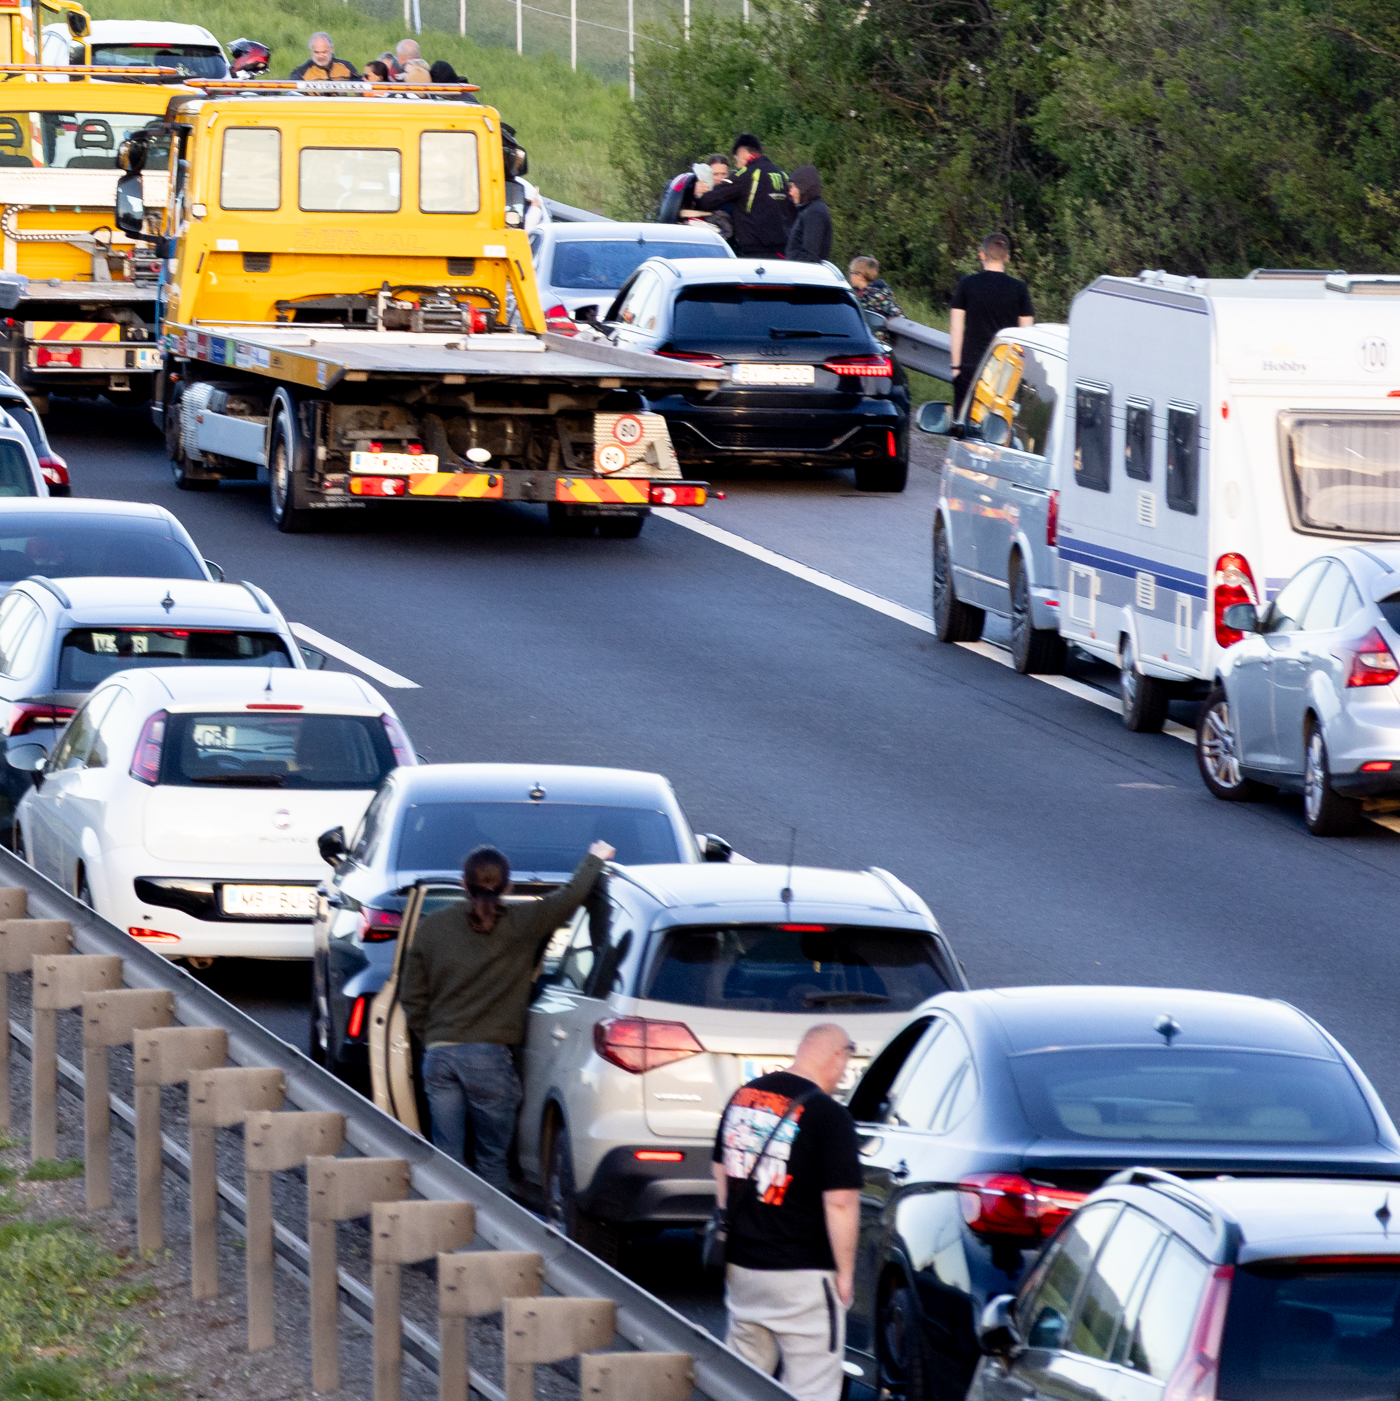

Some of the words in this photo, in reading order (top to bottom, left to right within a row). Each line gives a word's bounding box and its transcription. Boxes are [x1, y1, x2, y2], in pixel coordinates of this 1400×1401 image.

[1361, 341, 1388, 367] 100
[1262, 360, 1307, 375] Hobby
[620, 423, 637, 438] 80
[604, 452, 620, 465] 90
